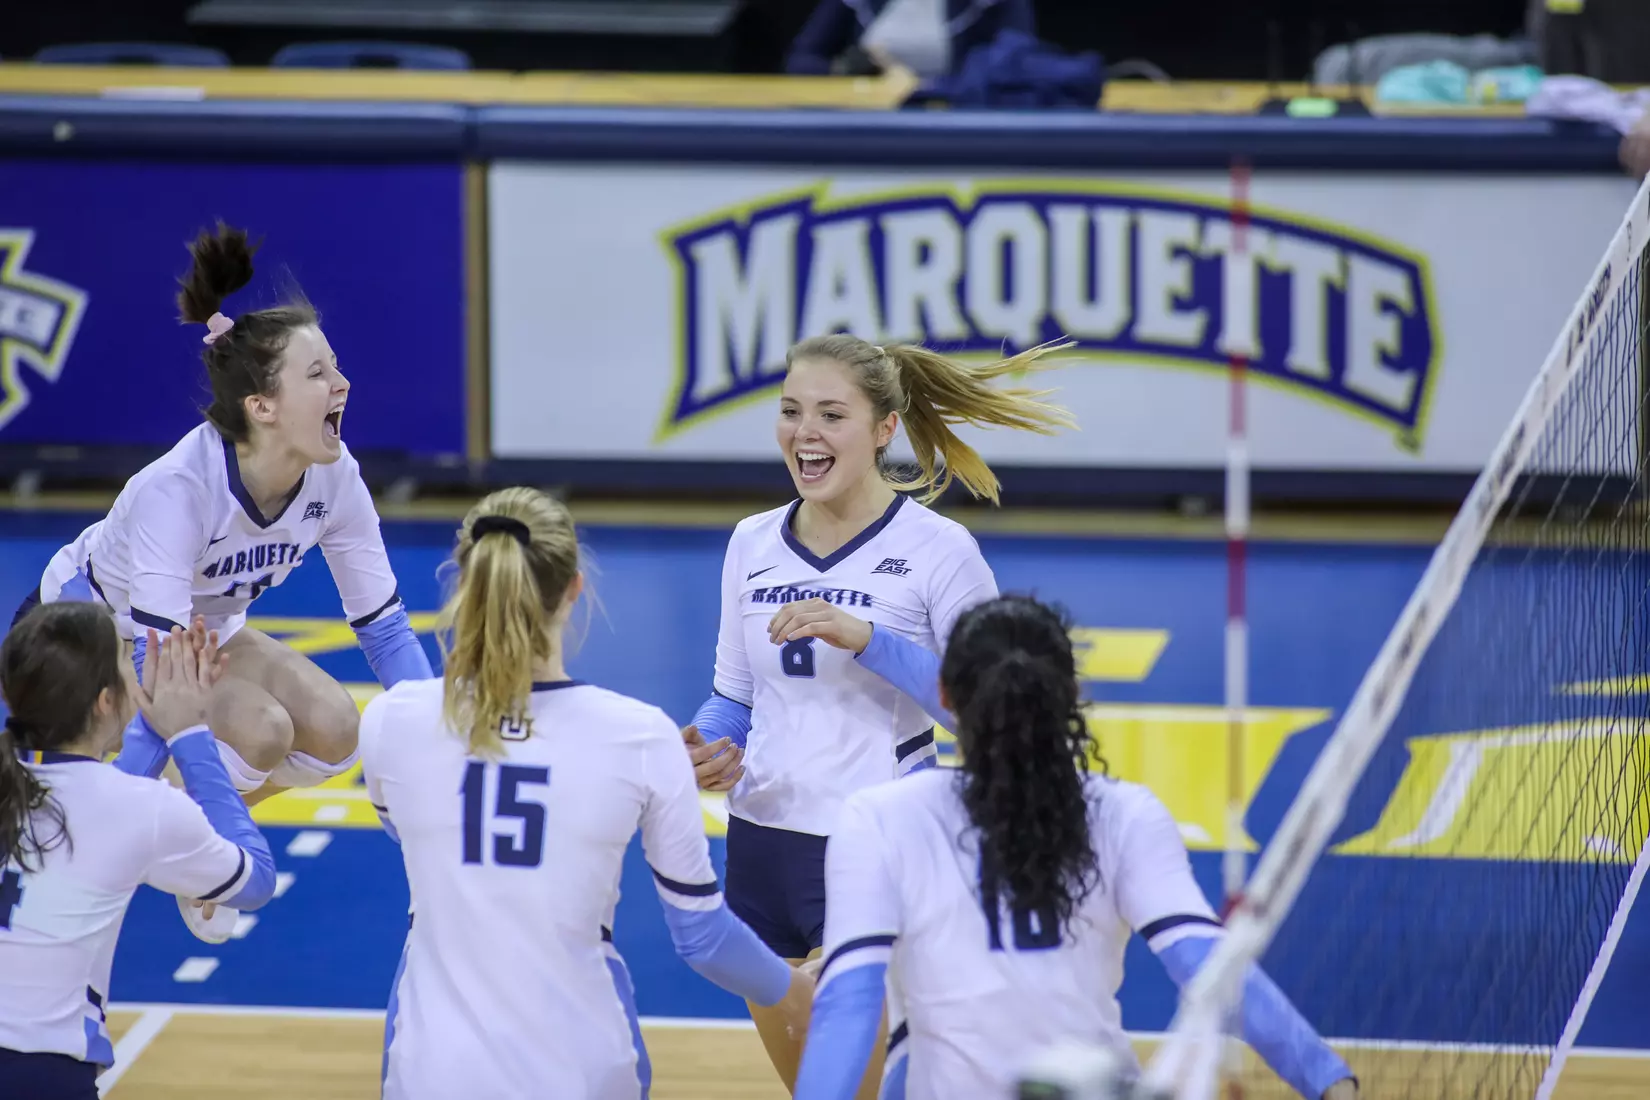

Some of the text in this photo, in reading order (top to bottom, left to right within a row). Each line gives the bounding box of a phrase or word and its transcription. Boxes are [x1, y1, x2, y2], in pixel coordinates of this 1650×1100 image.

[688, 201, 1419, 402] MARQUETTE
[306, 501, 325, 510] BIG
[303, 509, 329, 520] EAST
[201, 543, 303, 579] MARUETT
[881, 557, 908, 567] BIG
[874, 564, 913, 575] EAST
[458, 759, 551, 869] 15
